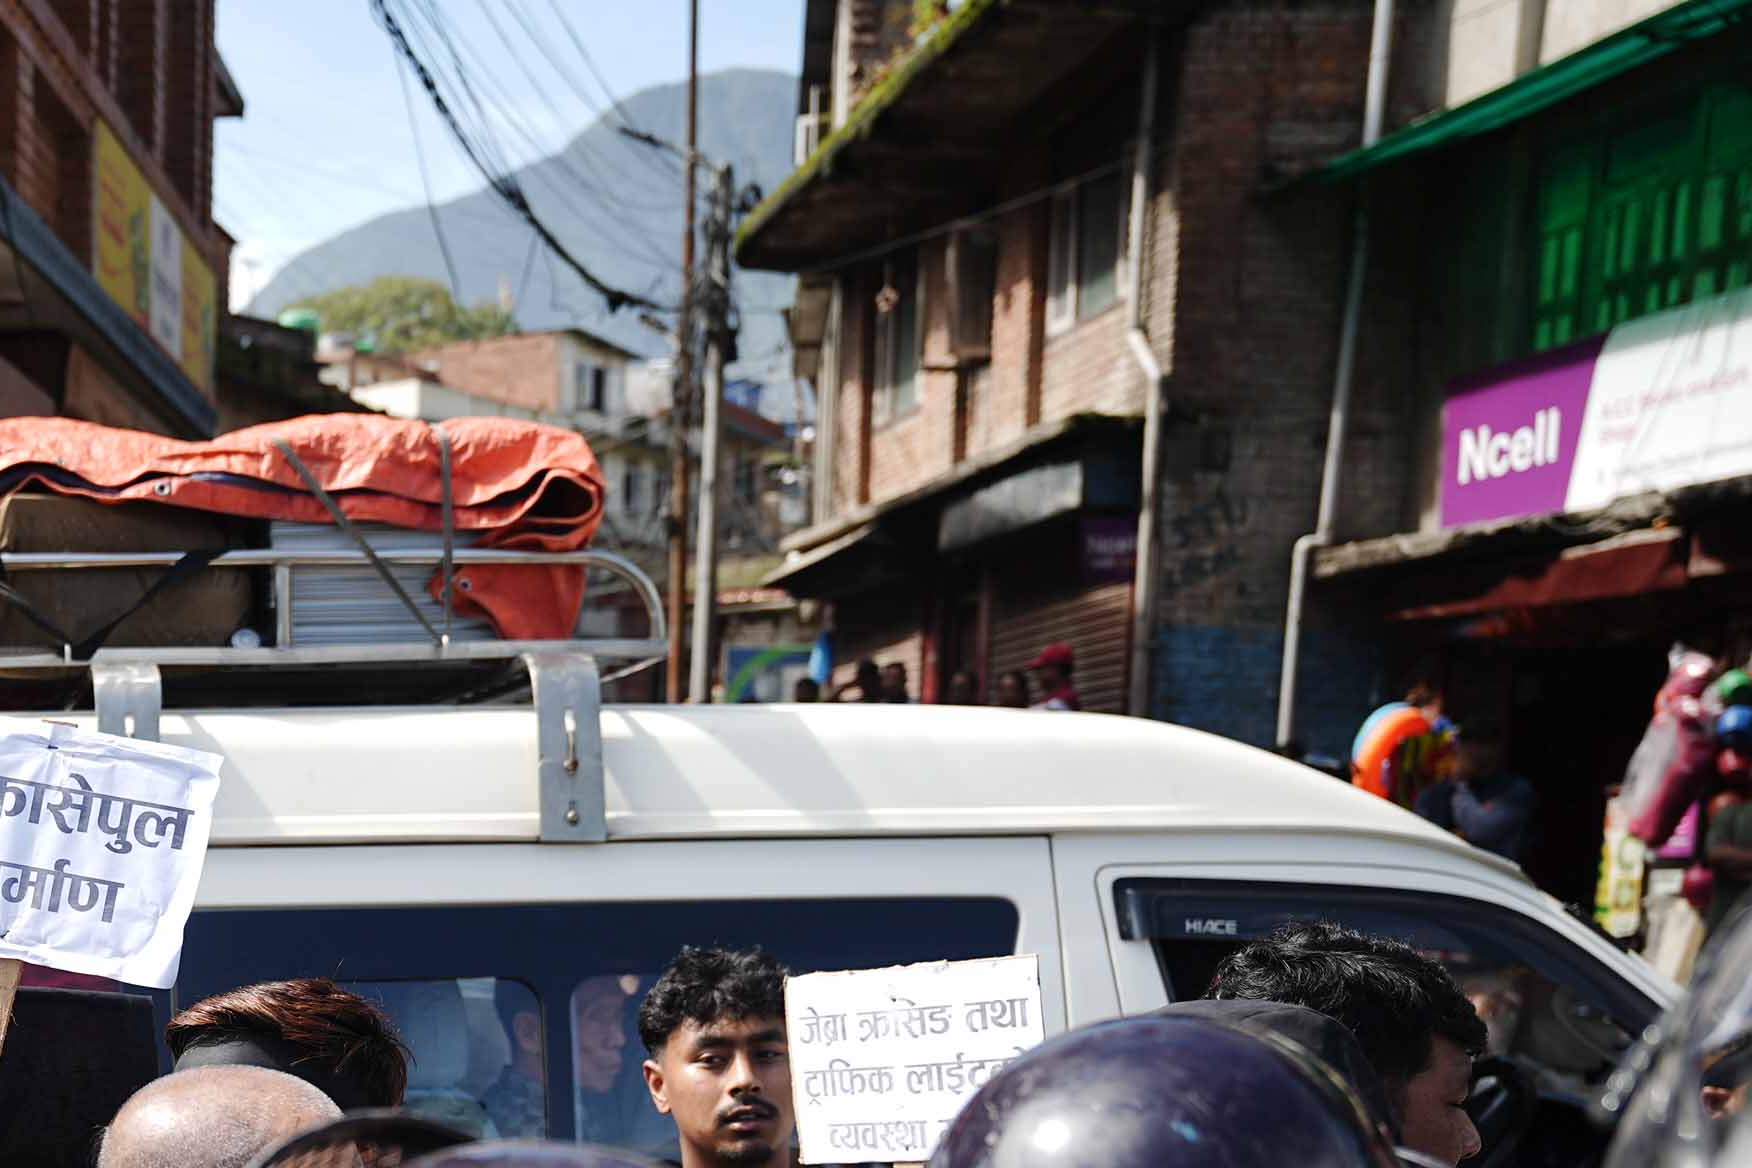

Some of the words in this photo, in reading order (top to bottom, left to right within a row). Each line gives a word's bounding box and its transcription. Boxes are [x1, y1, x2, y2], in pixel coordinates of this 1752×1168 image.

[1457, 406, 1561, 486] Ncell
[1184, 918, 1238, 935] HIACE
[798, 1006, 848, 1046] जेब्रा
[964, 997, 1029, 1033] तथा
[804, 1057, 895, 1107] ट्राफिक
[828, 1119, 928, 1152] व्यवस्था
